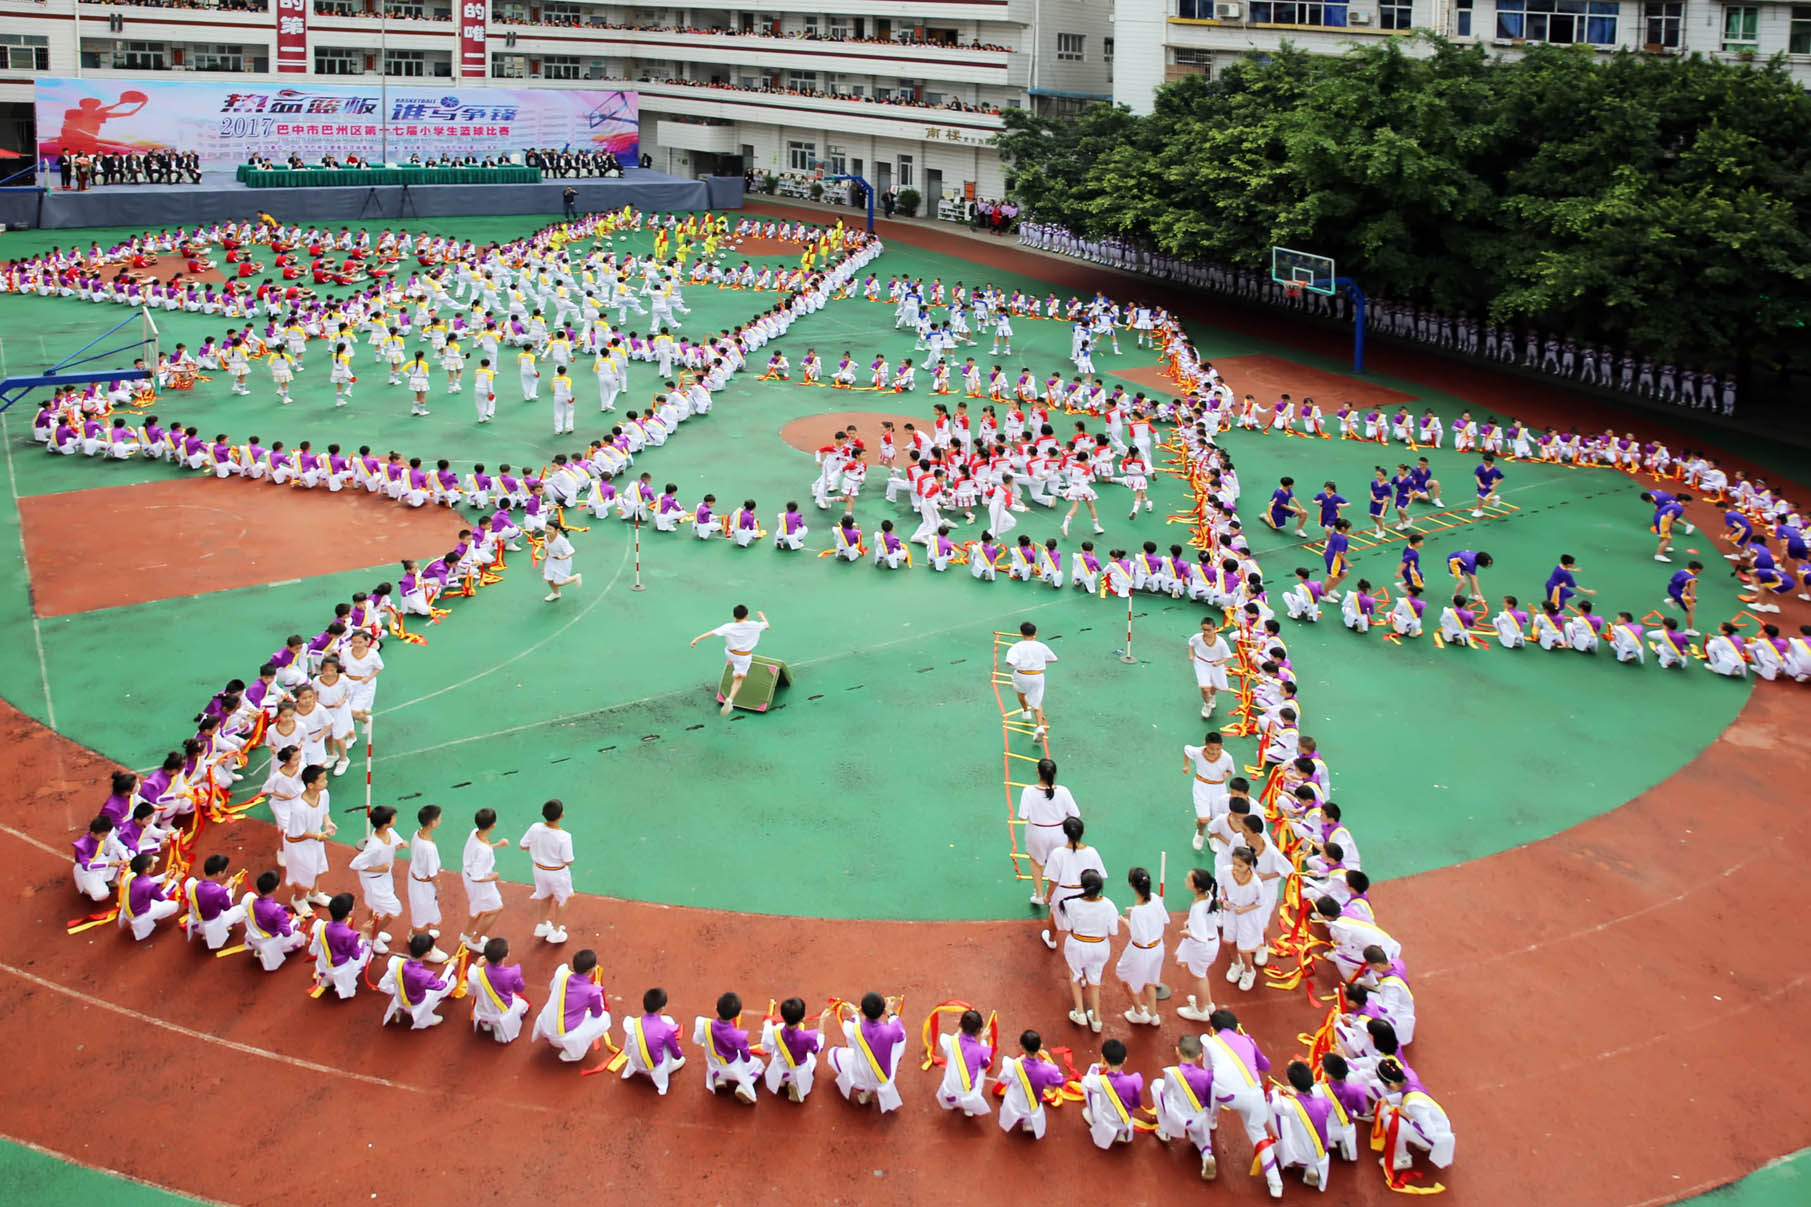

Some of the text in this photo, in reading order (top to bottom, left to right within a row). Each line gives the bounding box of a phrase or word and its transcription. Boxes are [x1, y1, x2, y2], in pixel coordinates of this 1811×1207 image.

[220, 89, 380, 114] 热血篮板
[391, 103, 520, 121] 谁与争锋
[219, 117, 276, 138] 2017
